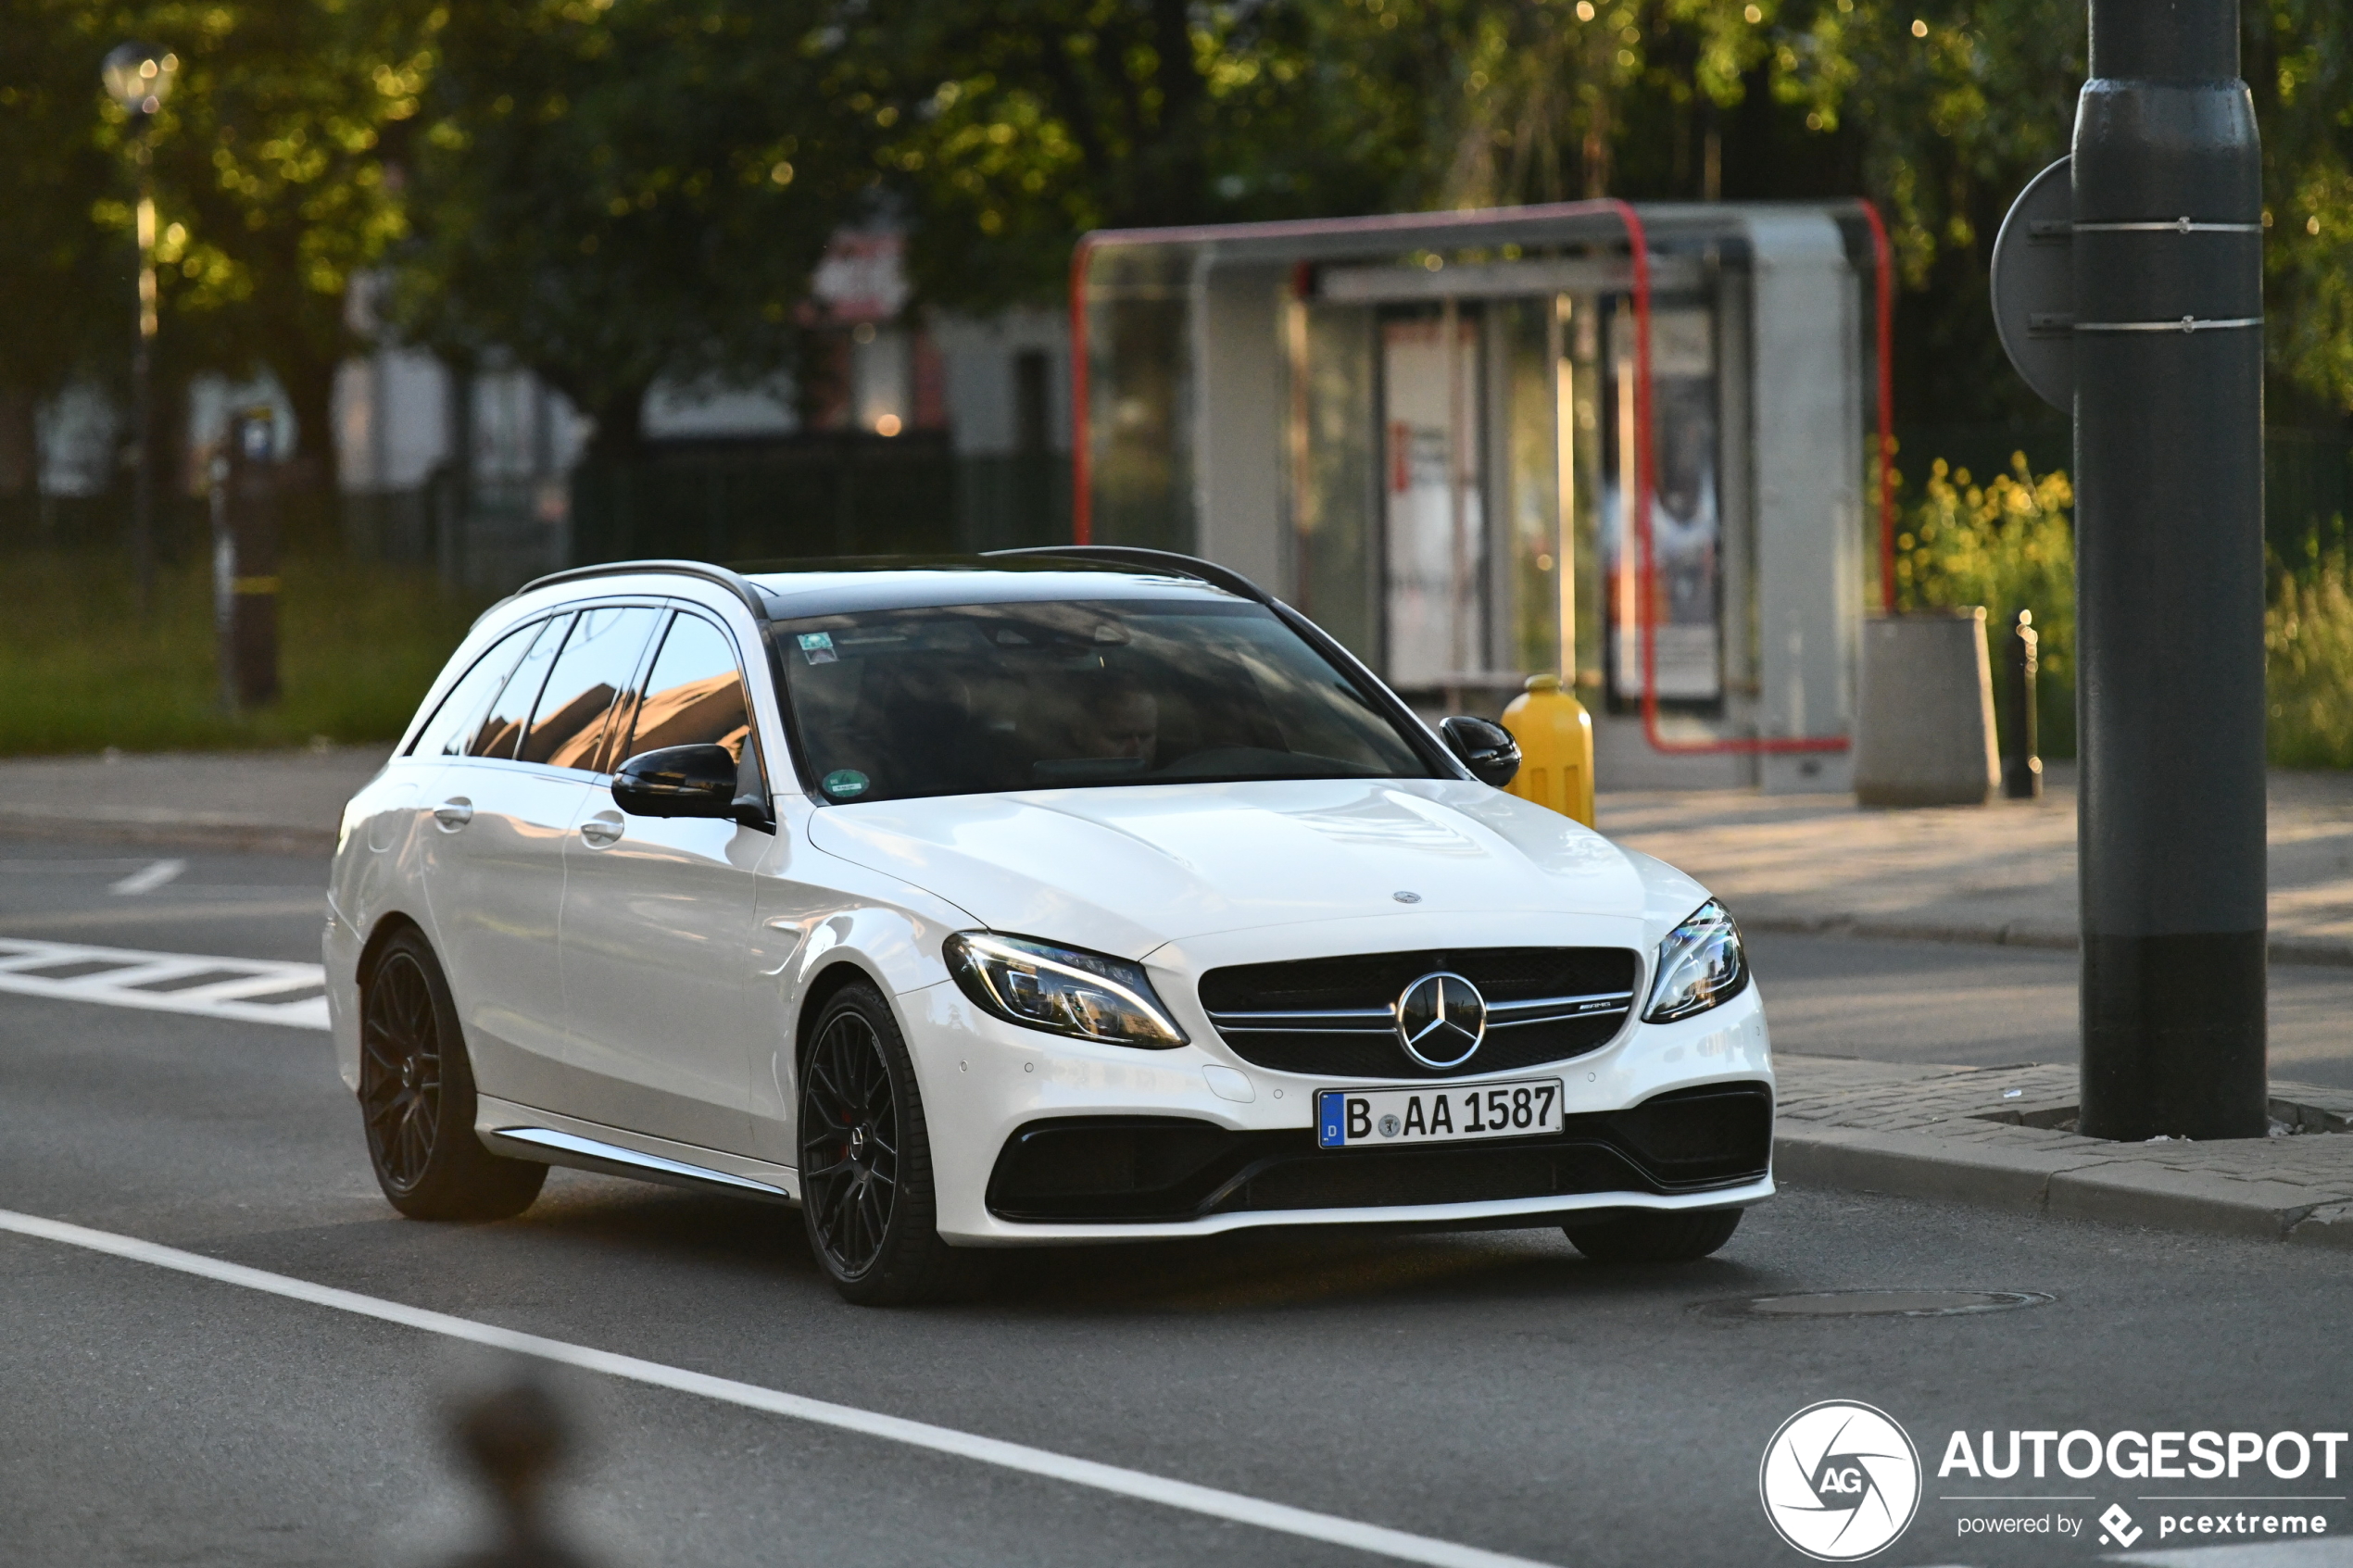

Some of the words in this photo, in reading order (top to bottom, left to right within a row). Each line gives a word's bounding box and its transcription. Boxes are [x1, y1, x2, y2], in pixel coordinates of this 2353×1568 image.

[1347, 1098, 1372, 1139] B
[1403, 1095, 1453, 1135] AA
[1465, 1085, 1555, 1133] 1587
[1327, 1125, 1337, 1137] D
